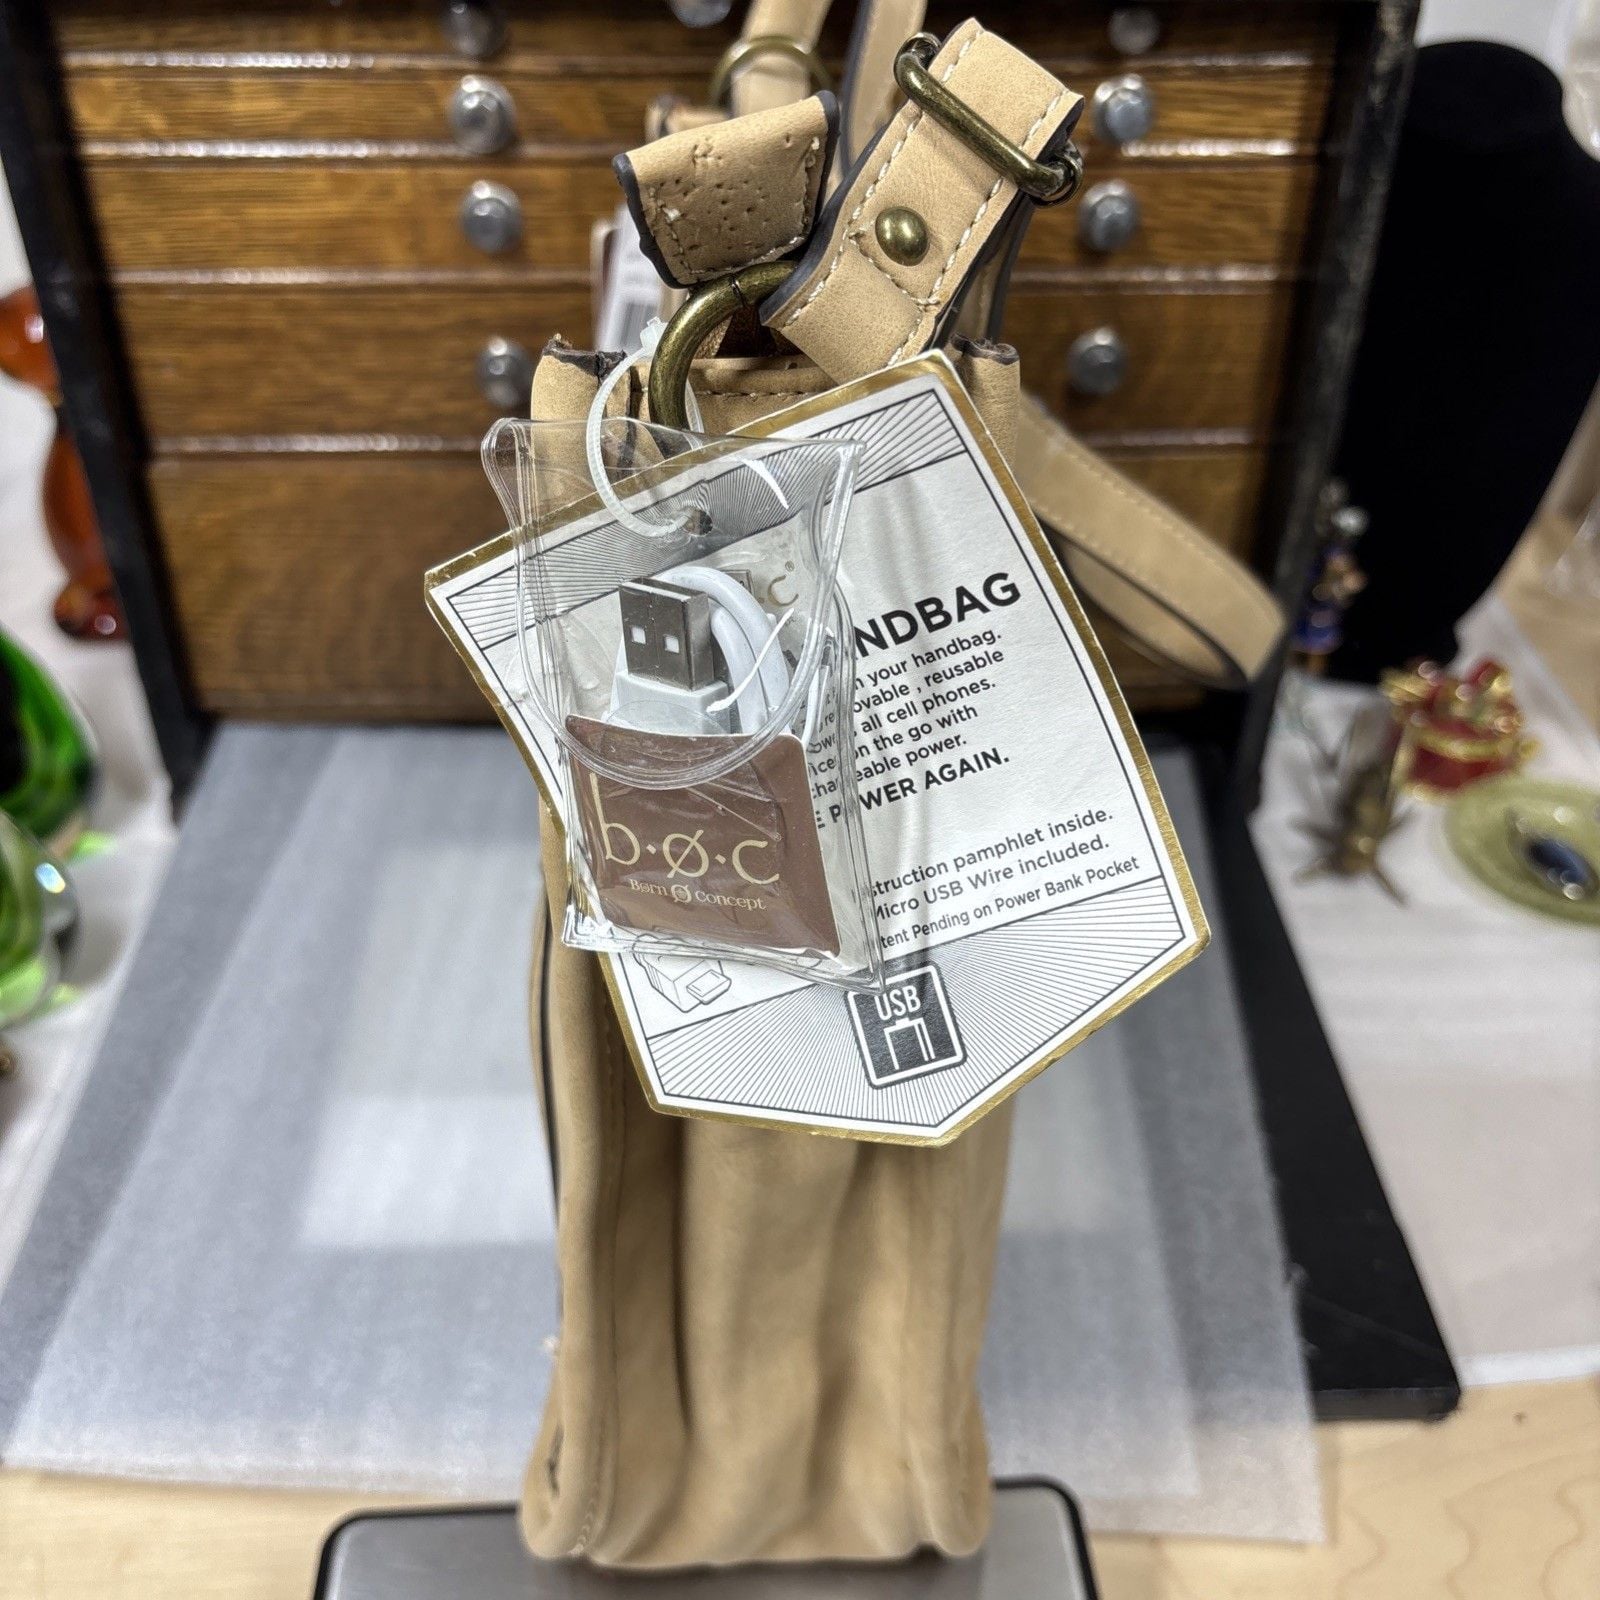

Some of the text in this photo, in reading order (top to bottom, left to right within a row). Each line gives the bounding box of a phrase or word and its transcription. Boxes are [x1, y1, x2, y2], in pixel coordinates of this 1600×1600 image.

[854, 572, 1021, 658] NDBAG
[867, 660, 908, 687] your
[911, 629, 1002, 668] handbag.
[924, 650, 1005, 687] reusable
[861, 678, 996, 733] all cell phones.
[873, 732, 904, 752] the
[908, 722, 933, 742] go
[936, 704, 979, 729] with
[905, 733, 967, 766] power.
[829, 777, 917, 823] PWER
[924, 746, 1010, 790] AGAIN.
[923, 880, 964, 904] USB
[967, 866, 1014, 890] Wire
[1017, 833, 1110, 875] included.
[953, 828, 1045, 873] pamphlet
[1047, 809, 1113, 838] inside.
[880, 856, 1140, 948] tent Pending on Power Bank Pocket
[873, 985, 921, 1021] USB
